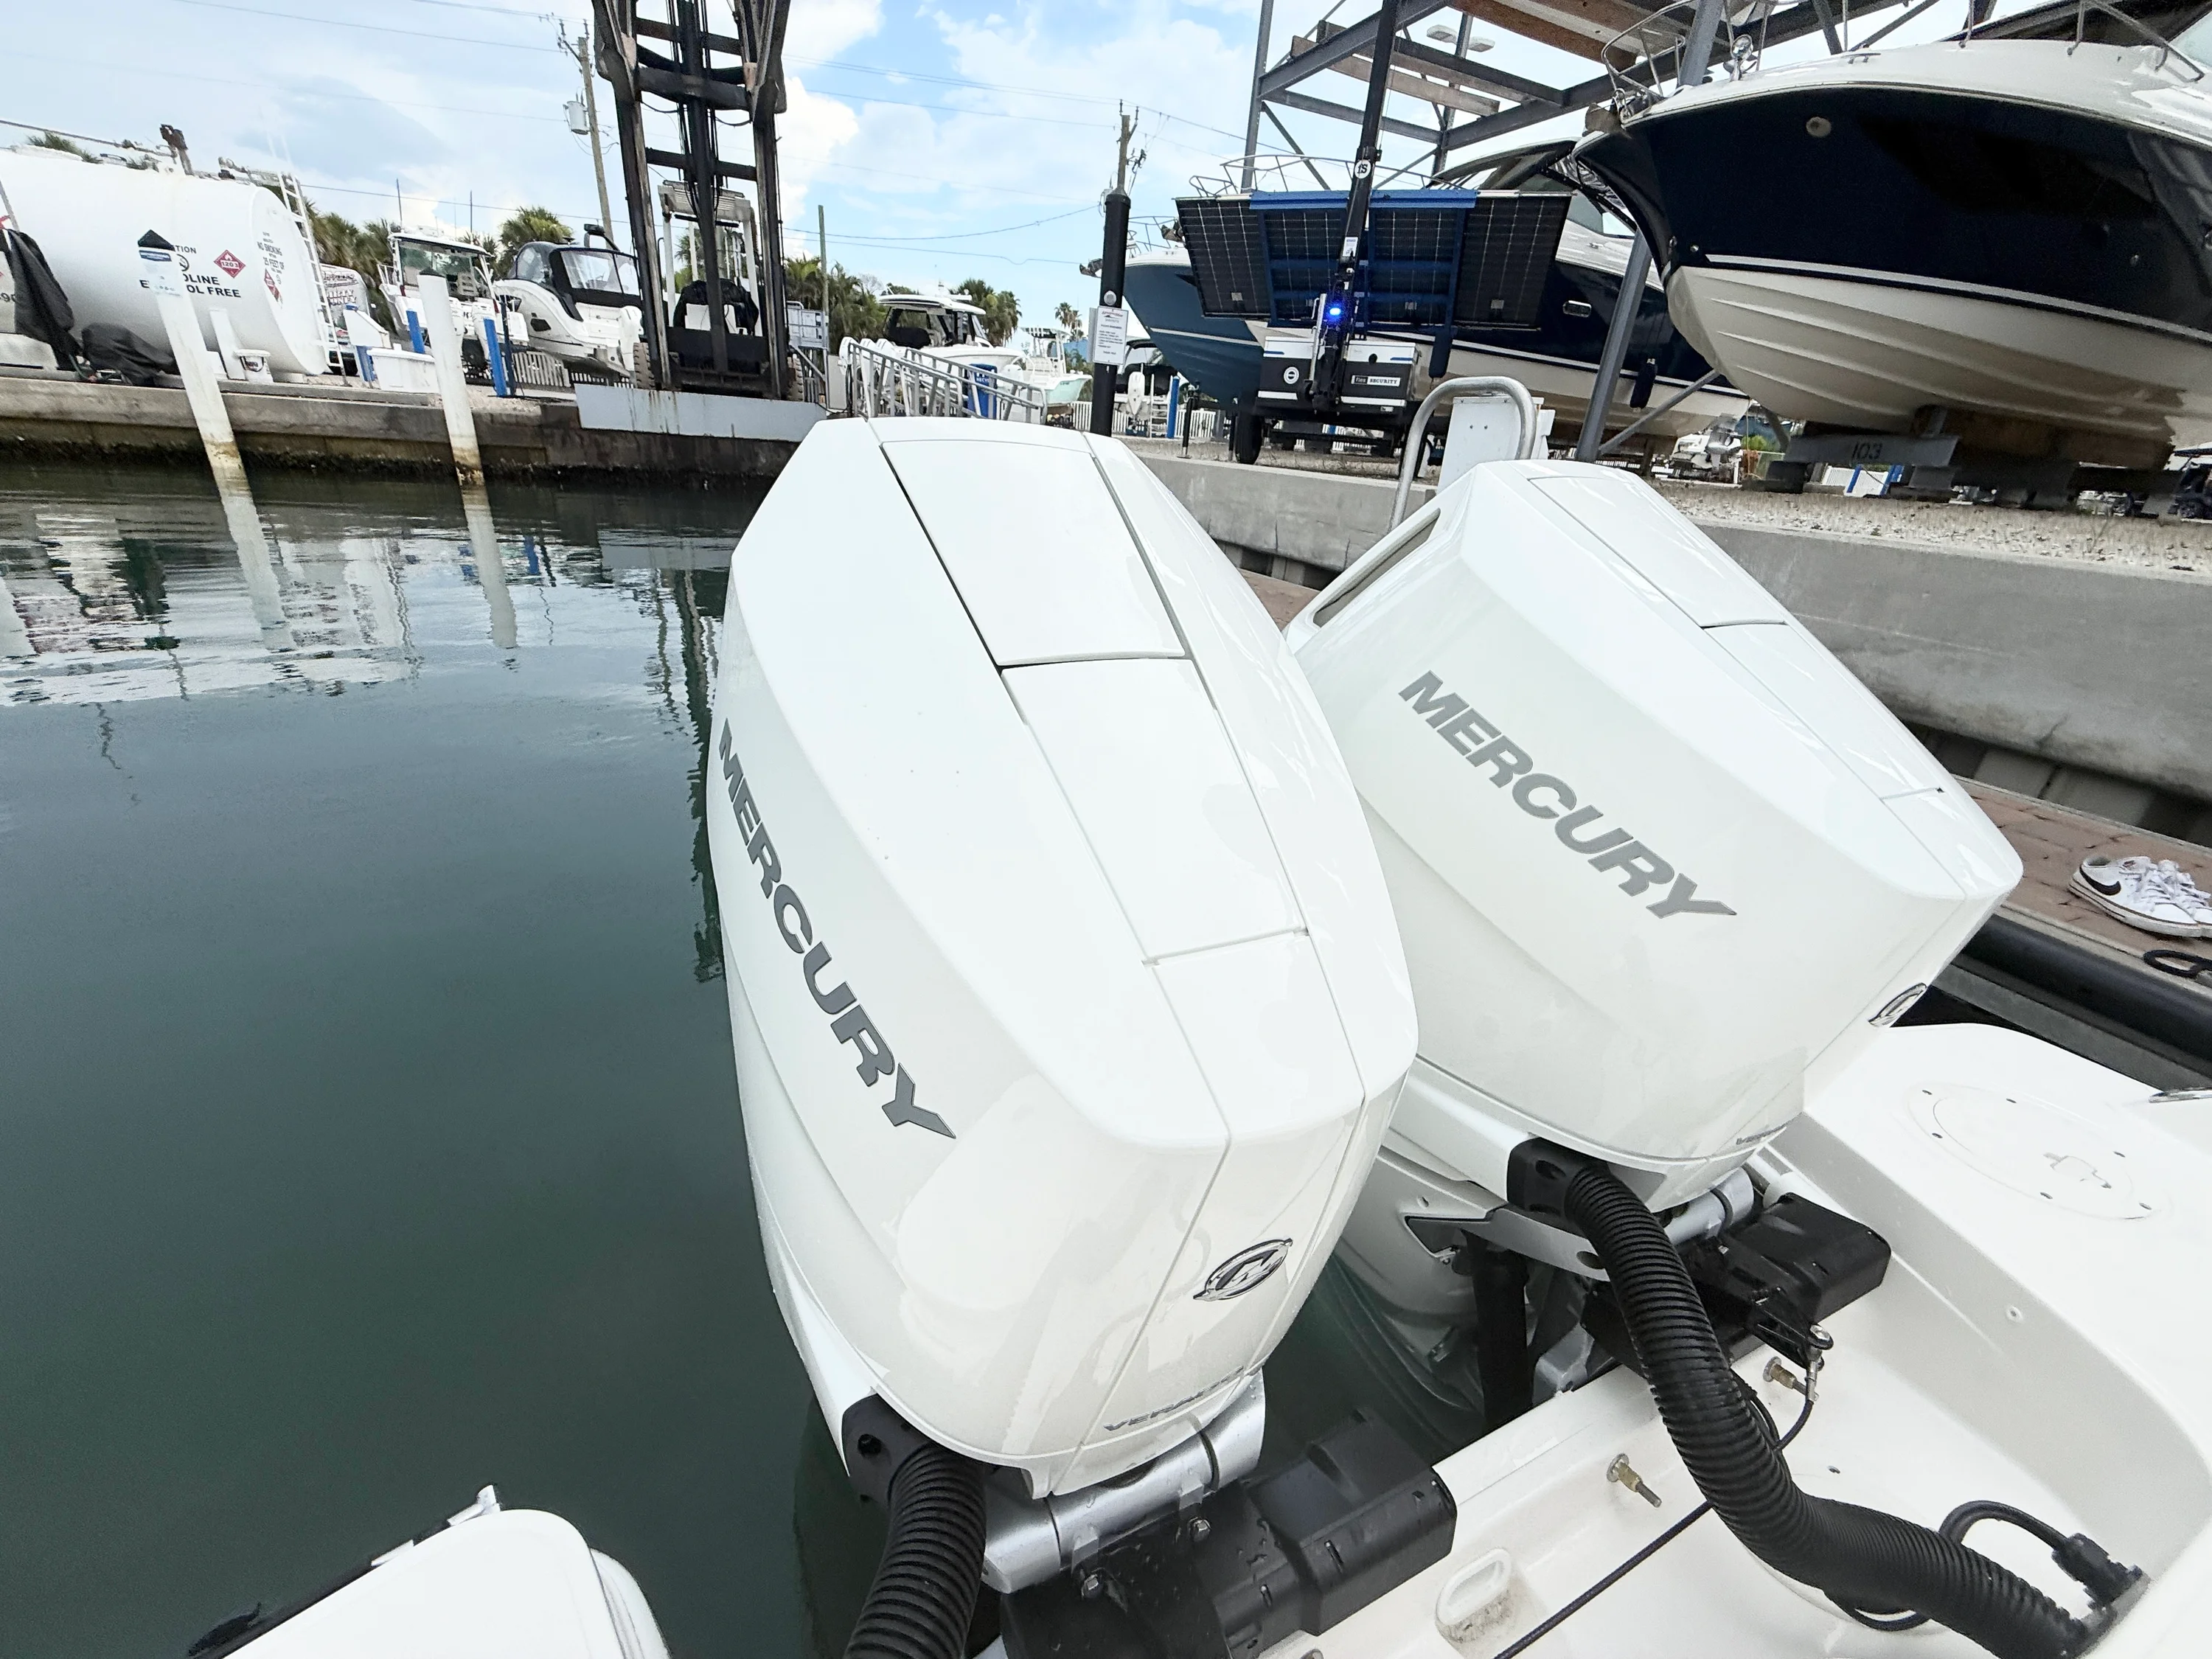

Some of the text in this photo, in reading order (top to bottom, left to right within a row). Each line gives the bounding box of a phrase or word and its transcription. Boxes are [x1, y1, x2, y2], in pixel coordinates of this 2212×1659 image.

[175, 245, 197, 254] TION
[207, 286, 241, 298] FREE
[1398, 669, 1737, 919] MERCURY
[719, 717, 956, 1139] MERCURY
